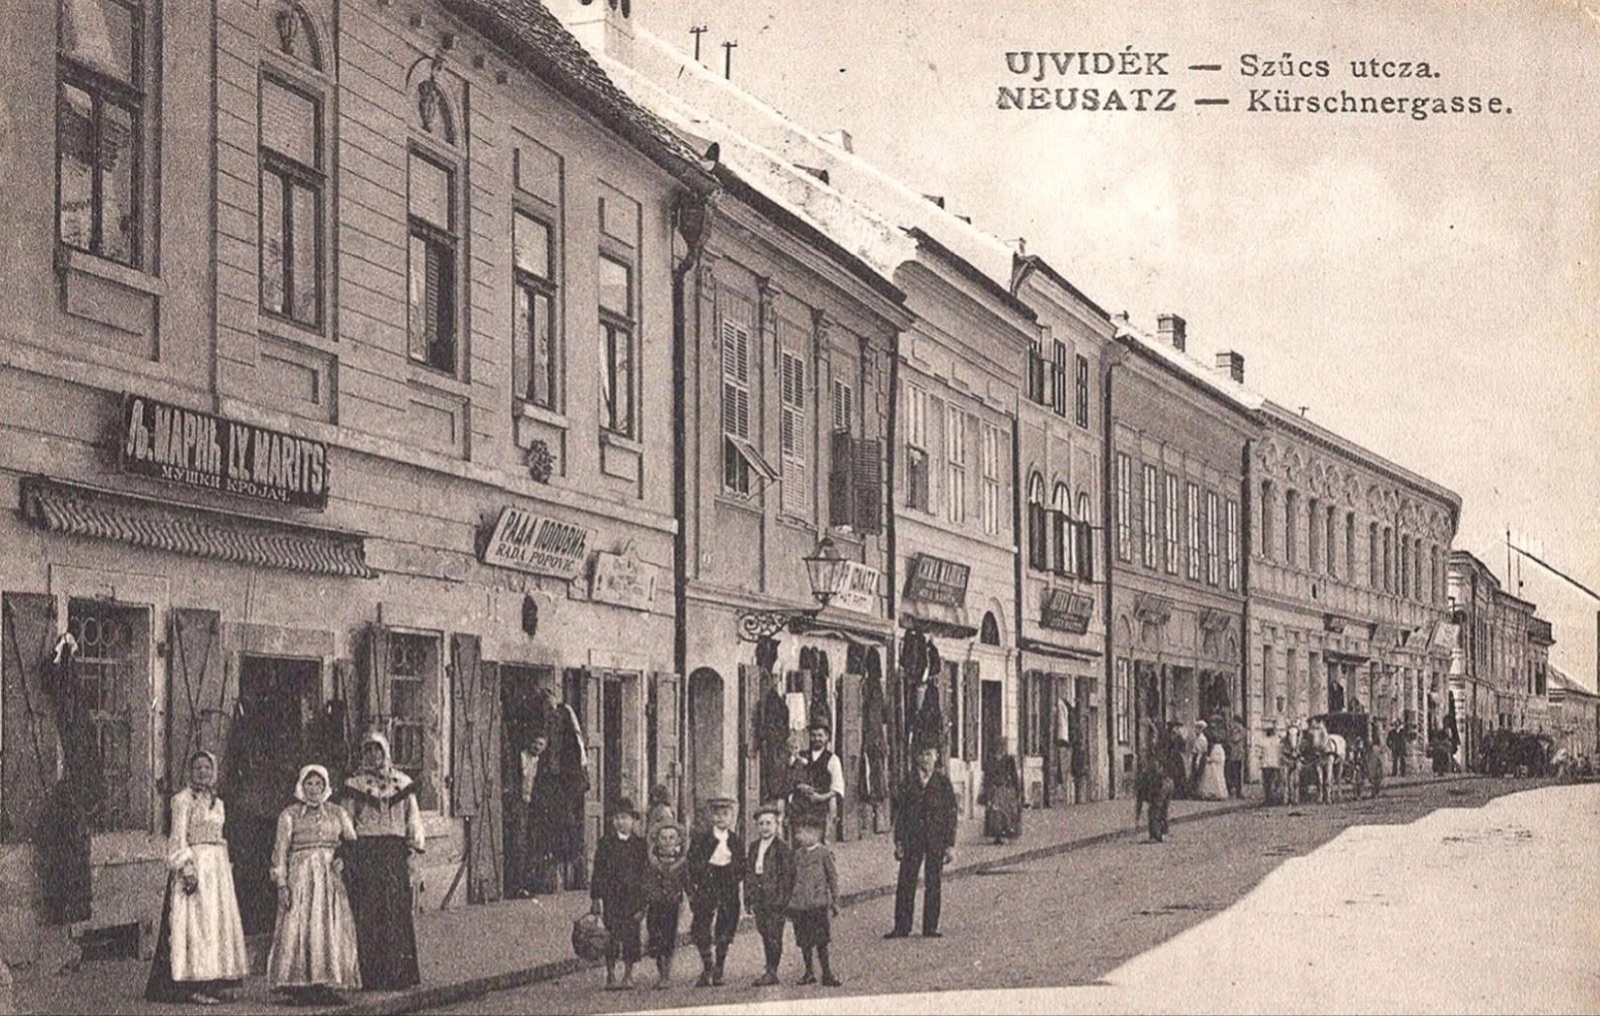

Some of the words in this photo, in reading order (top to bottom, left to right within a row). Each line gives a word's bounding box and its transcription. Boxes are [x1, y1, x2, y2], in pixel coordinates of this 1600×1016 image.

[162, 464, 220, 489] МУШКИ
[253, 429, 324, 495] MARITS
[500, 511, 538, 546] РАДА
[495, 543, 525, 561] RADA
